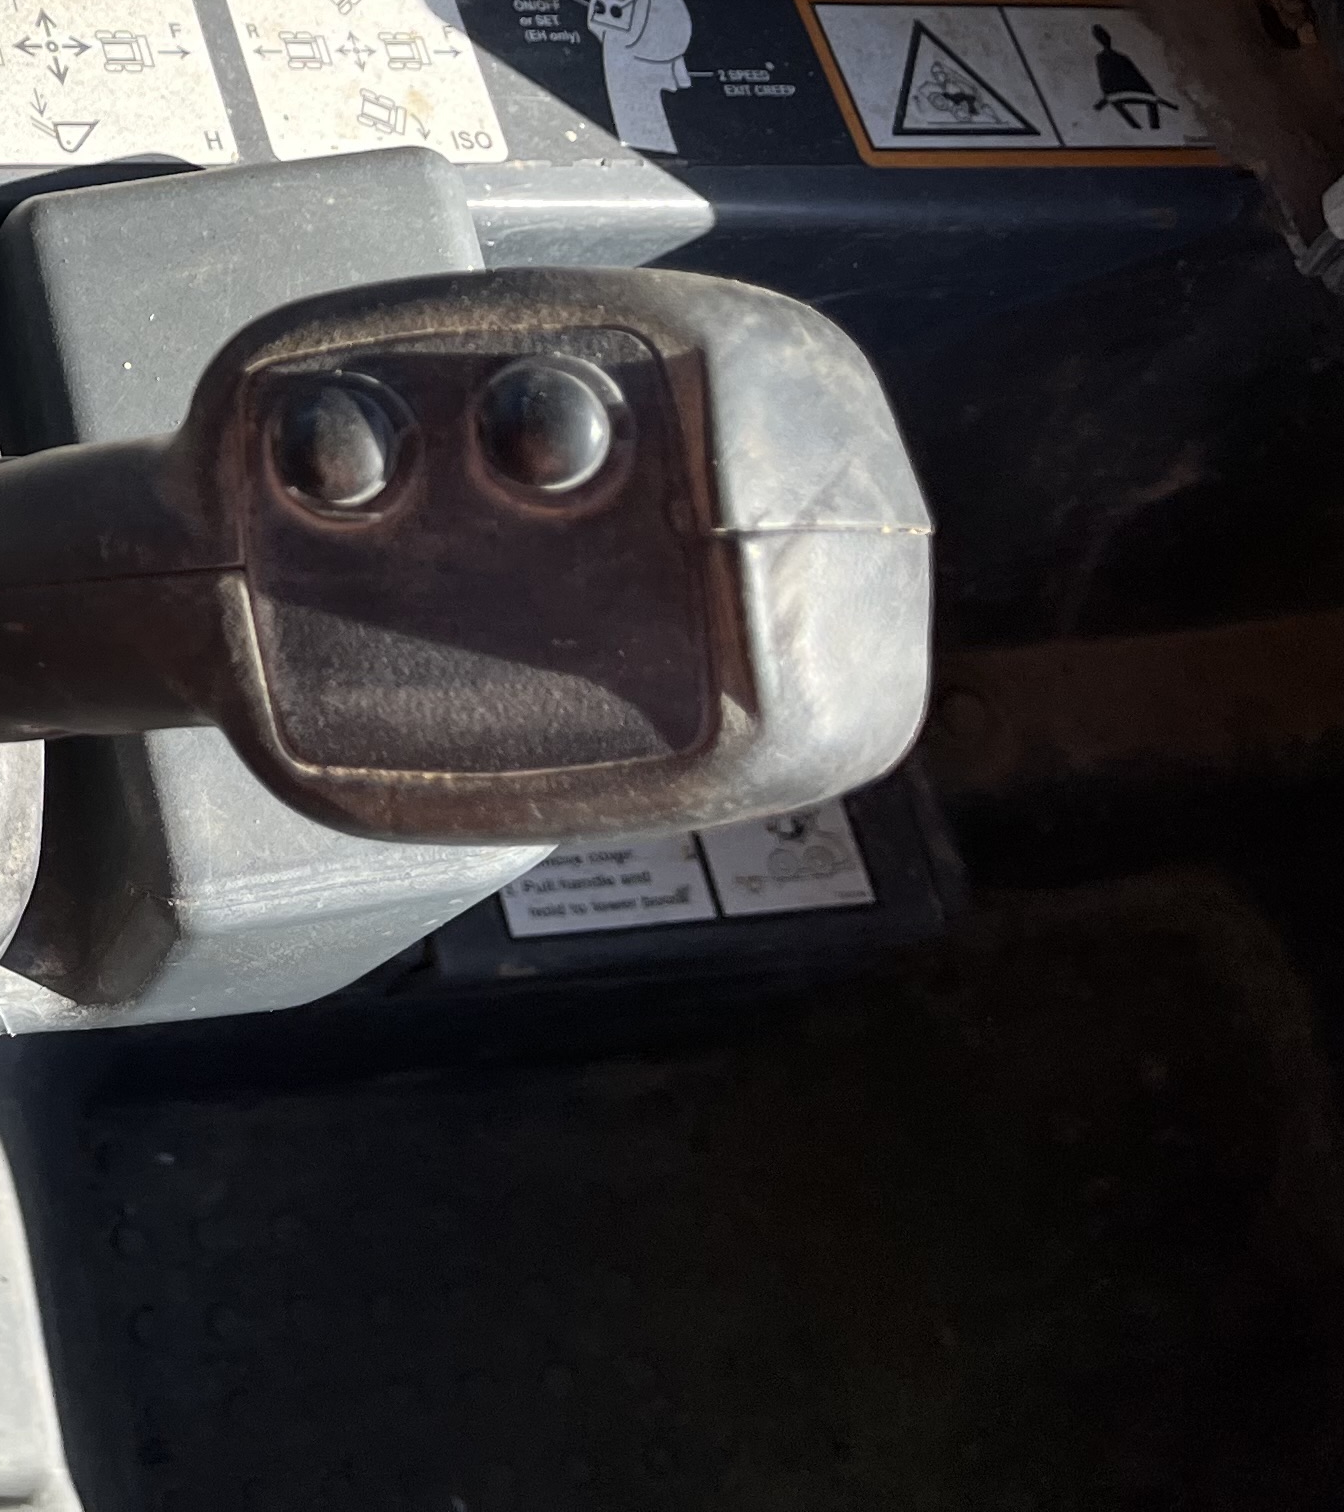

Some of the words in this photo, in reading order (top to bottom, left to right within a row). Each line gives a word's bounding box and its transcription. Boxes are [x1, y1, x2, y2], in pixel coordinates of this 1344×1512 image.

[168, 23, 183, 38] F
[245, 24, 260, 38] R
[728, 69, 770, 82] SPEED
[204, 131, 223, 150] H
[450, 131, 493, 150] ISO
